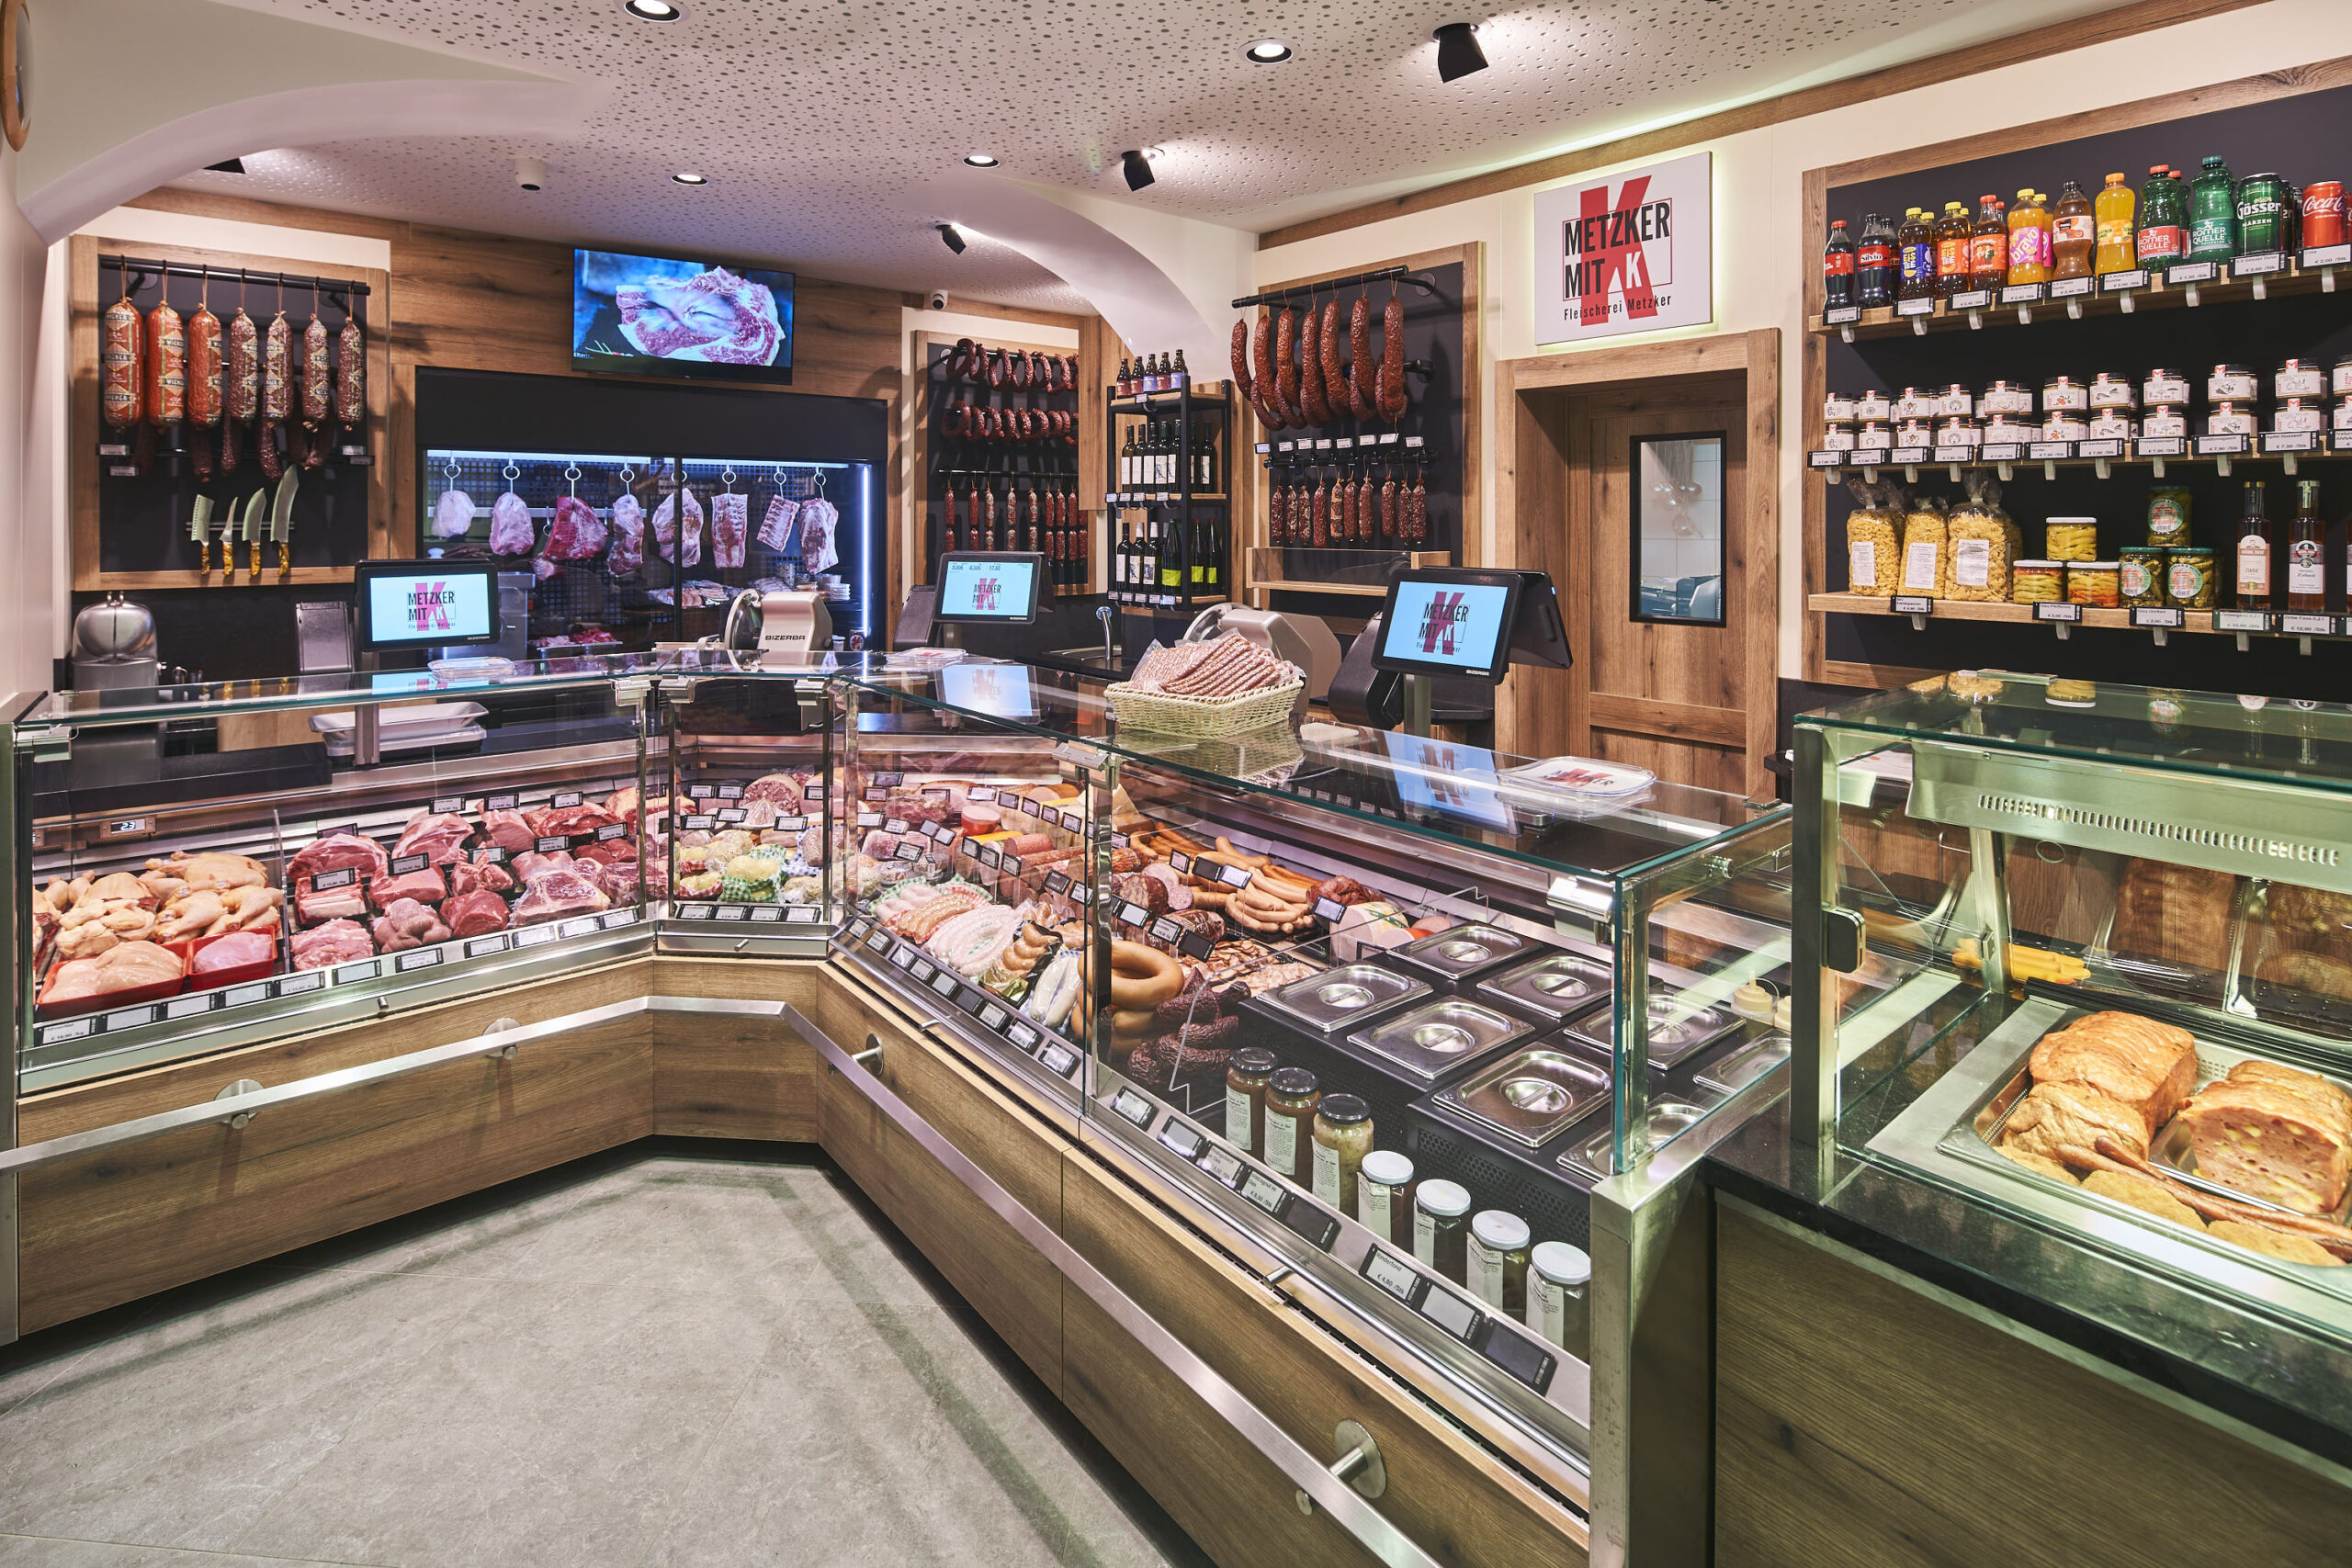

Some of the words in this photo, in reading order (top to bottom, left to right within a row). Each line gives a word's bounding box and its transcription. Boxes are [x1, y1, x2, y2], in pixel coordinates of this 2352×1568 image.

[2236, 200, 2281, 220] Gösser
[2302, 195, 2345, 217] Coca-C
[1565, 202, 1670, 256] METZKER
[2192, 226, 2226, 238] RÖMER
[2010, 228, 2039, 264] bravo
[2193, 235, 2225, 245] QUELLE
[1941, 248, 1955, 257] EIS
[2139, 243, 2169, 253] QUELLE
[1903, 253, 1917, 262] EIS
[1903, 260, 1917, 270] TEE
[1941, 256, 1955, 265] TEE
[1565, 258, 1605, 299] MIT
[1625, 251, 1642, 289] K
[1564, 299, 1623, 321] Fleischerei
[1628, 295, 1671, 311] Metzker
[973, 584, 1001, 593] METZKER
[408, 592, 454, 605] METZKER
[408, 608, 427, 621] MIT
[436, 606, 444, 620] K
[1423, 604, 1469, 623] METZKER
[1419, 622, 1438, 639] MIT
[1444, 625, 1453, 641] K
[1376, 1252, 1402, 1272] Rinderfond
